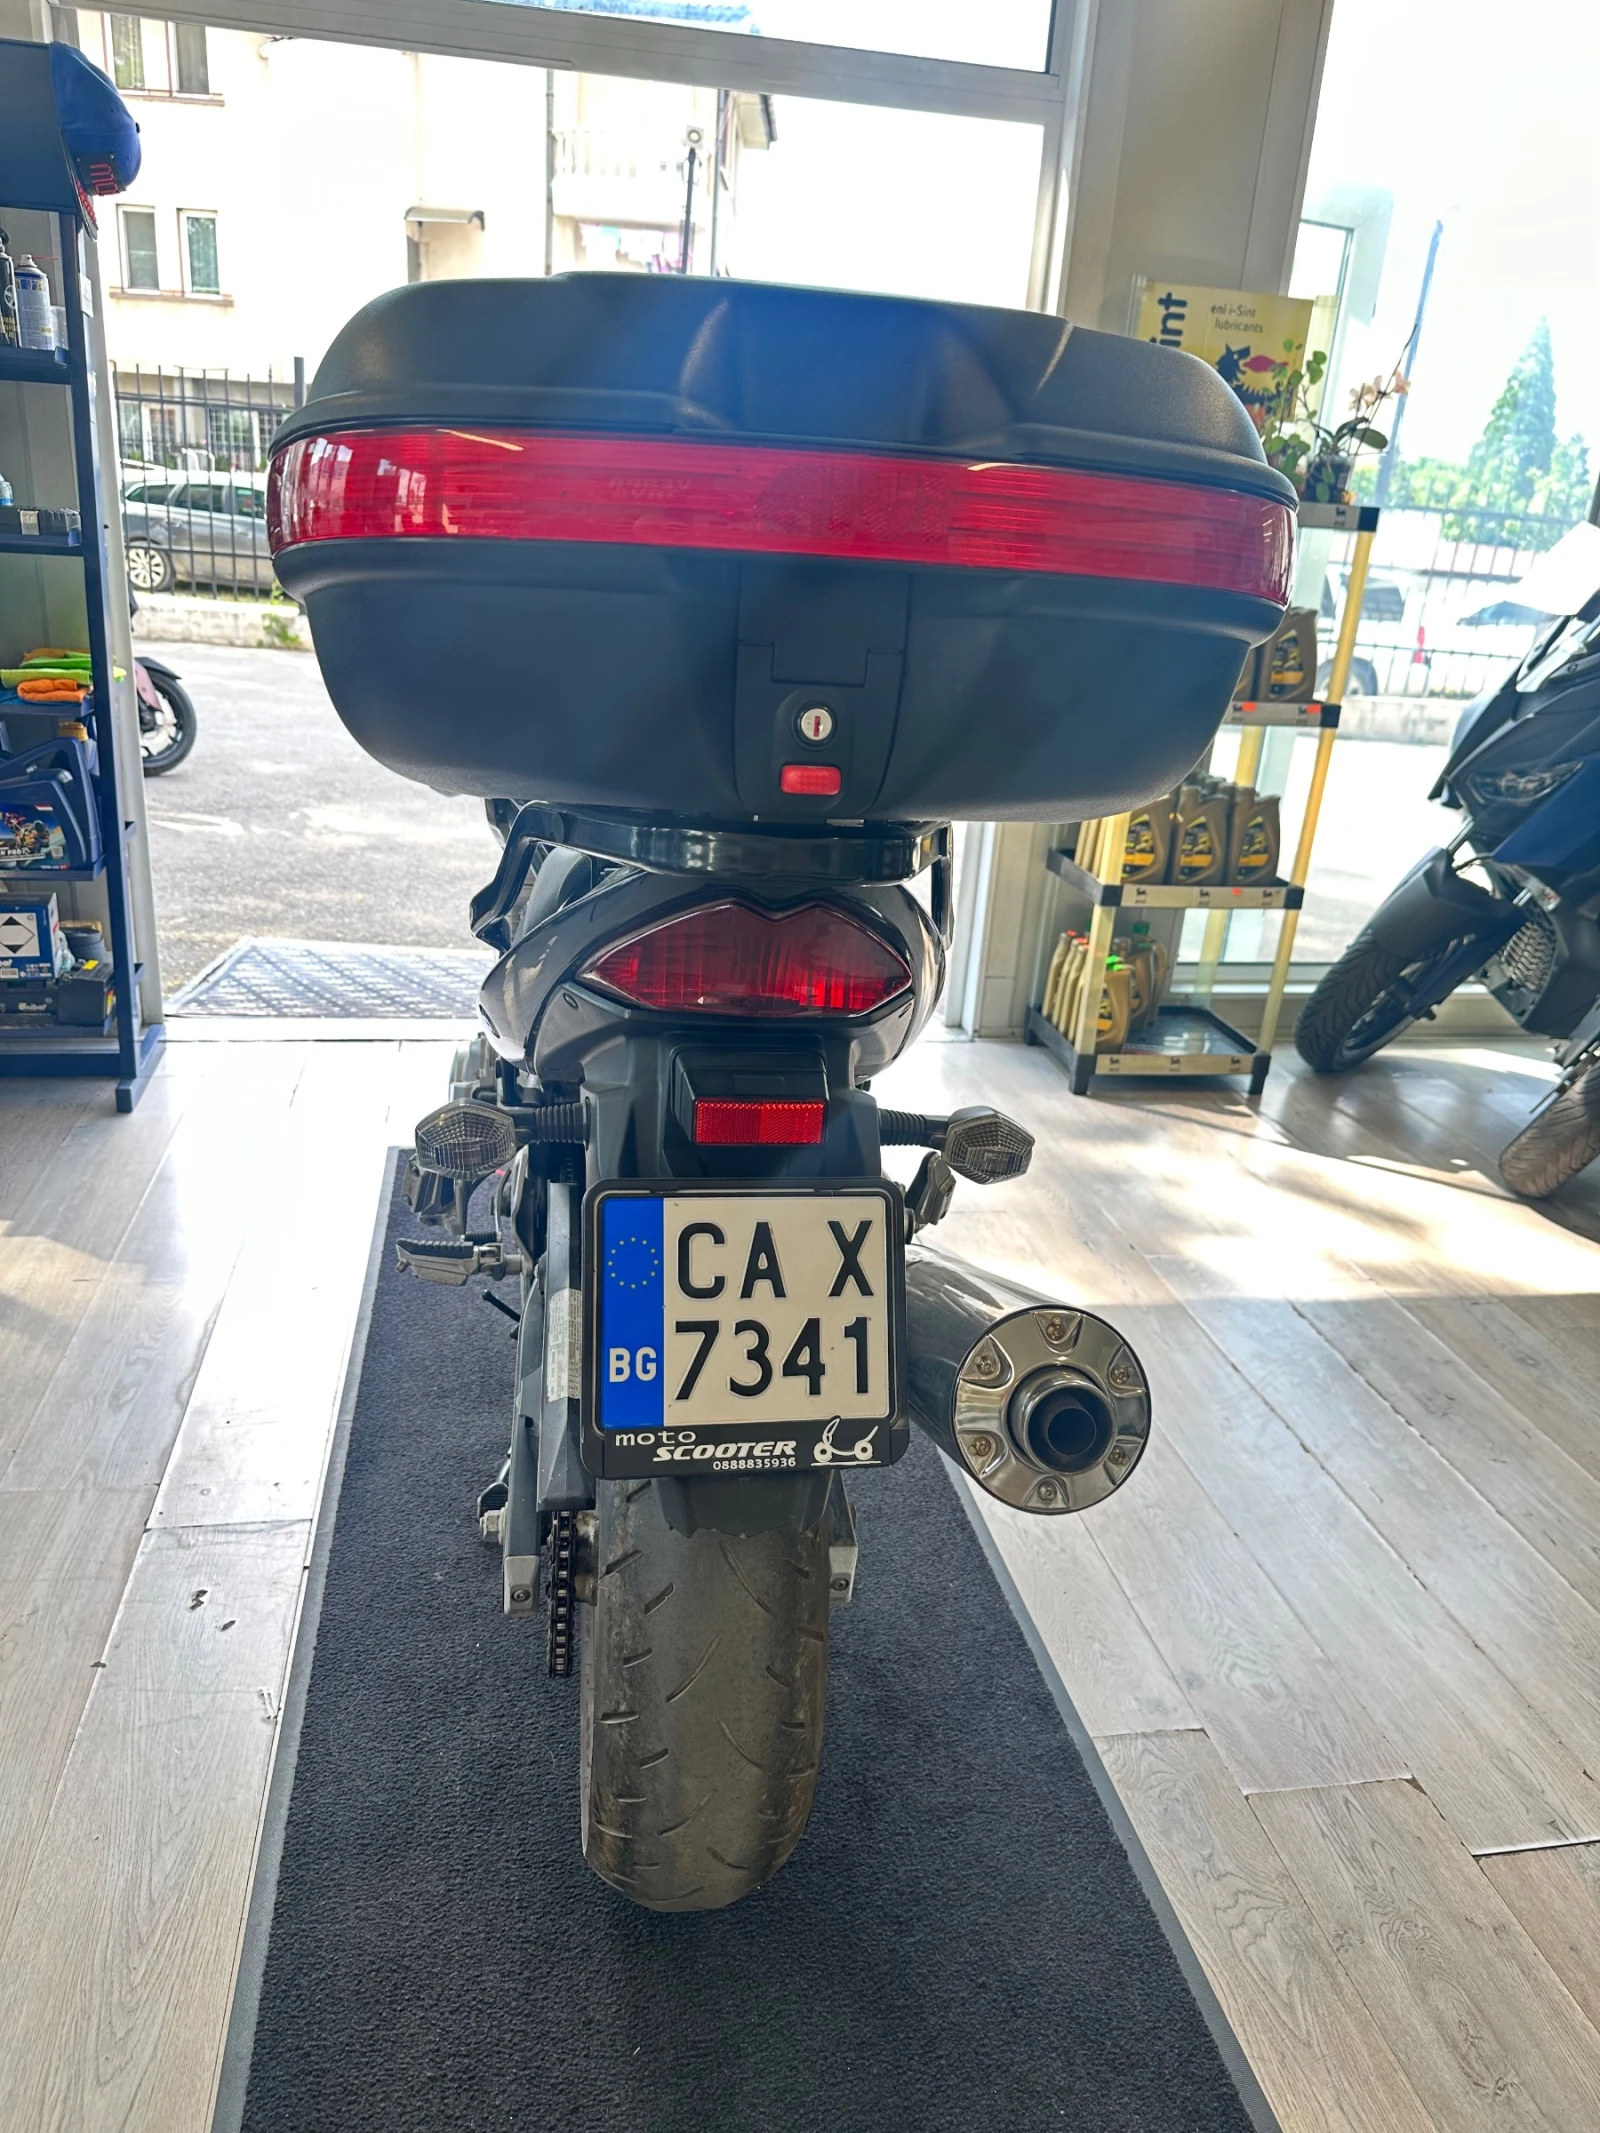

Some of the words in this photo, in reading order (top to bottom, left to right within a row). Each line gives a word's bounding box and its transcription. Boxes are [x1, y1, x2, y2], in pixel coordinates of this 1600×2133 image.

[1211, 304, 1227, 314] eni
[1215, 318, 1263, 333] lubricants
[677, 1221, 786, 1299] CA
[826, 1220, 874, 1297] X
[609, 1346, 657, 1383] BG
[675, 1316, 869, 1401] 7341
[615, 1430, 697, 1446] moto
[653, 1440, 797, 1462] SCOOTER
[712, 1457, 797, 1471] 0888835936
